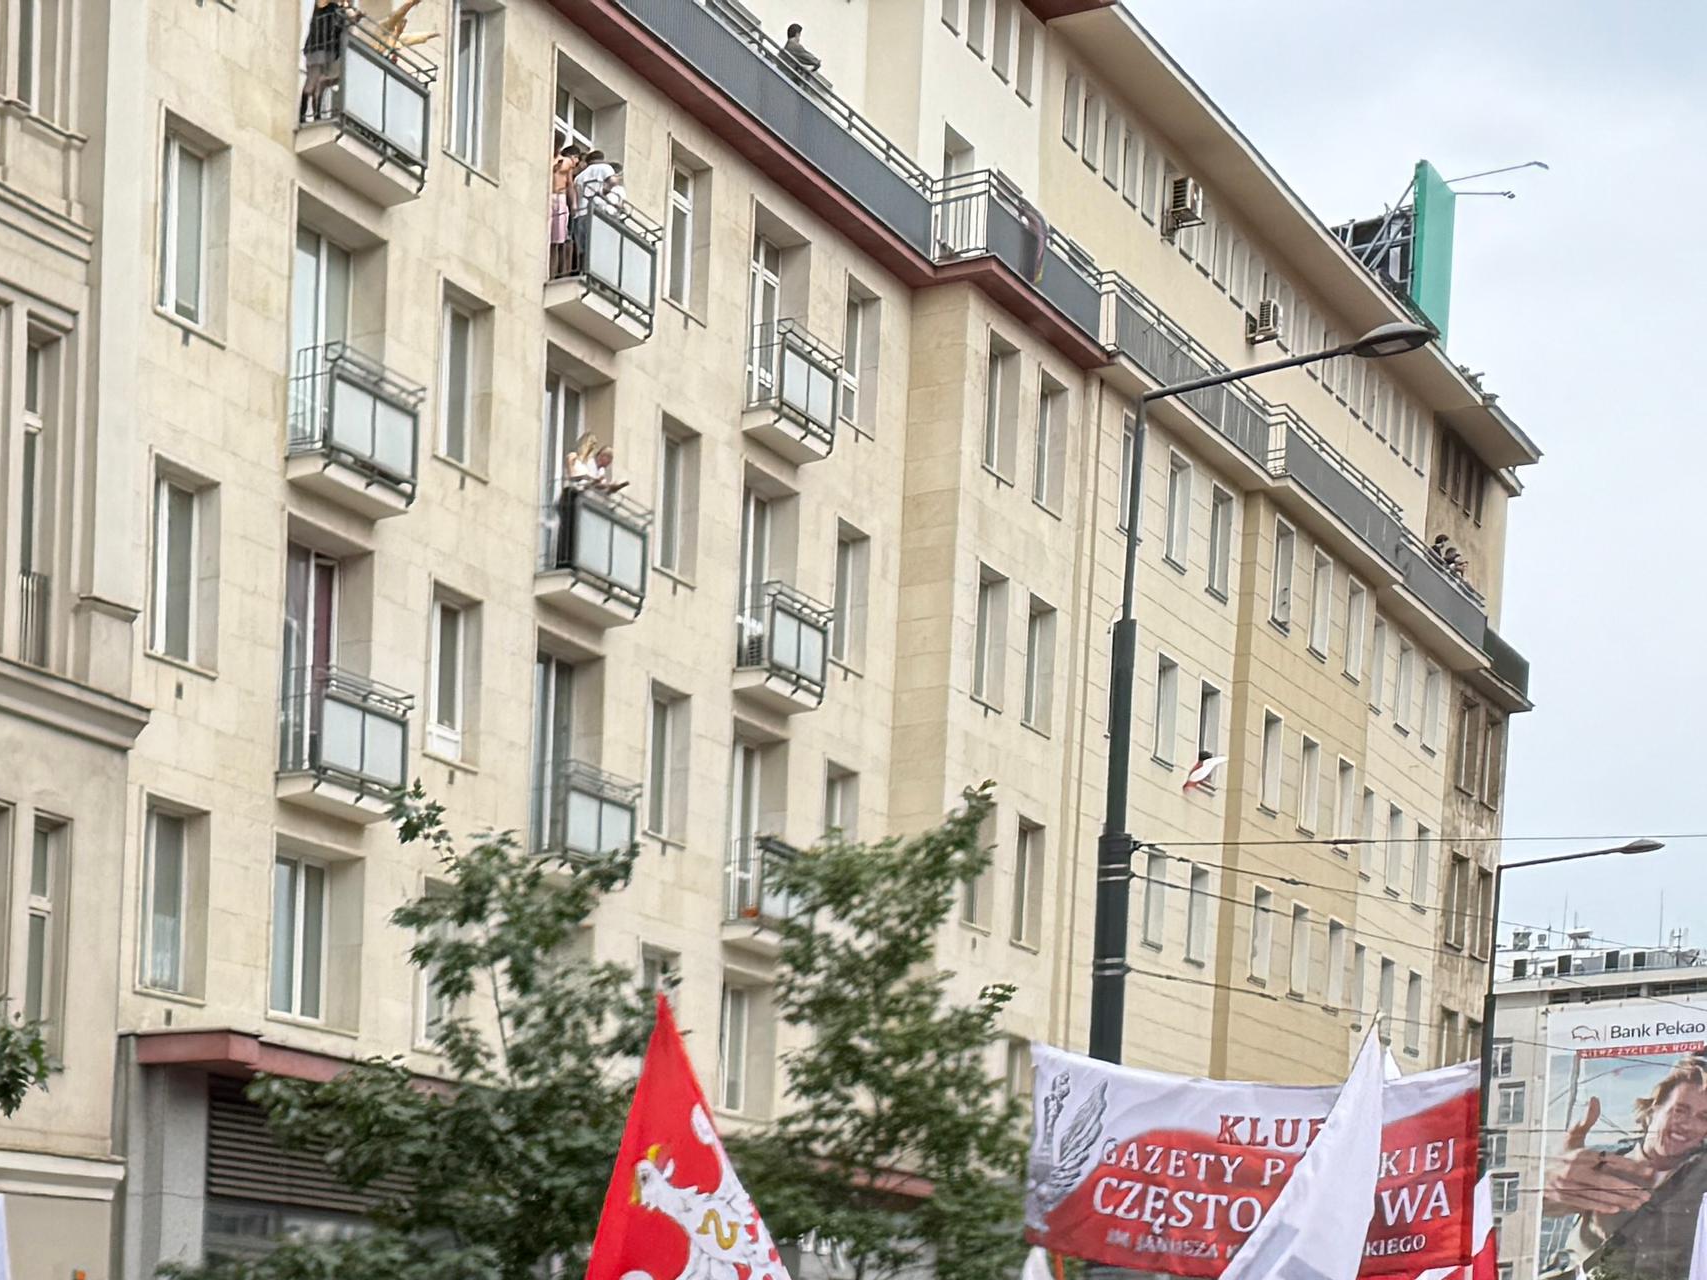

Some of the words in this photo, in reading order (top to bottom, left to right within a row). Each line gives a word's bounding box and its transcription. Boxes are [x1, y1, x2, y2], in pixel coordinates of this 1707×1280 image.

[1611, 1024, 1650, 1039] Bank
[1656, 1021, 1706, 1036] Pekao
[1101, 1137, 1246, 1184] GAZETY
